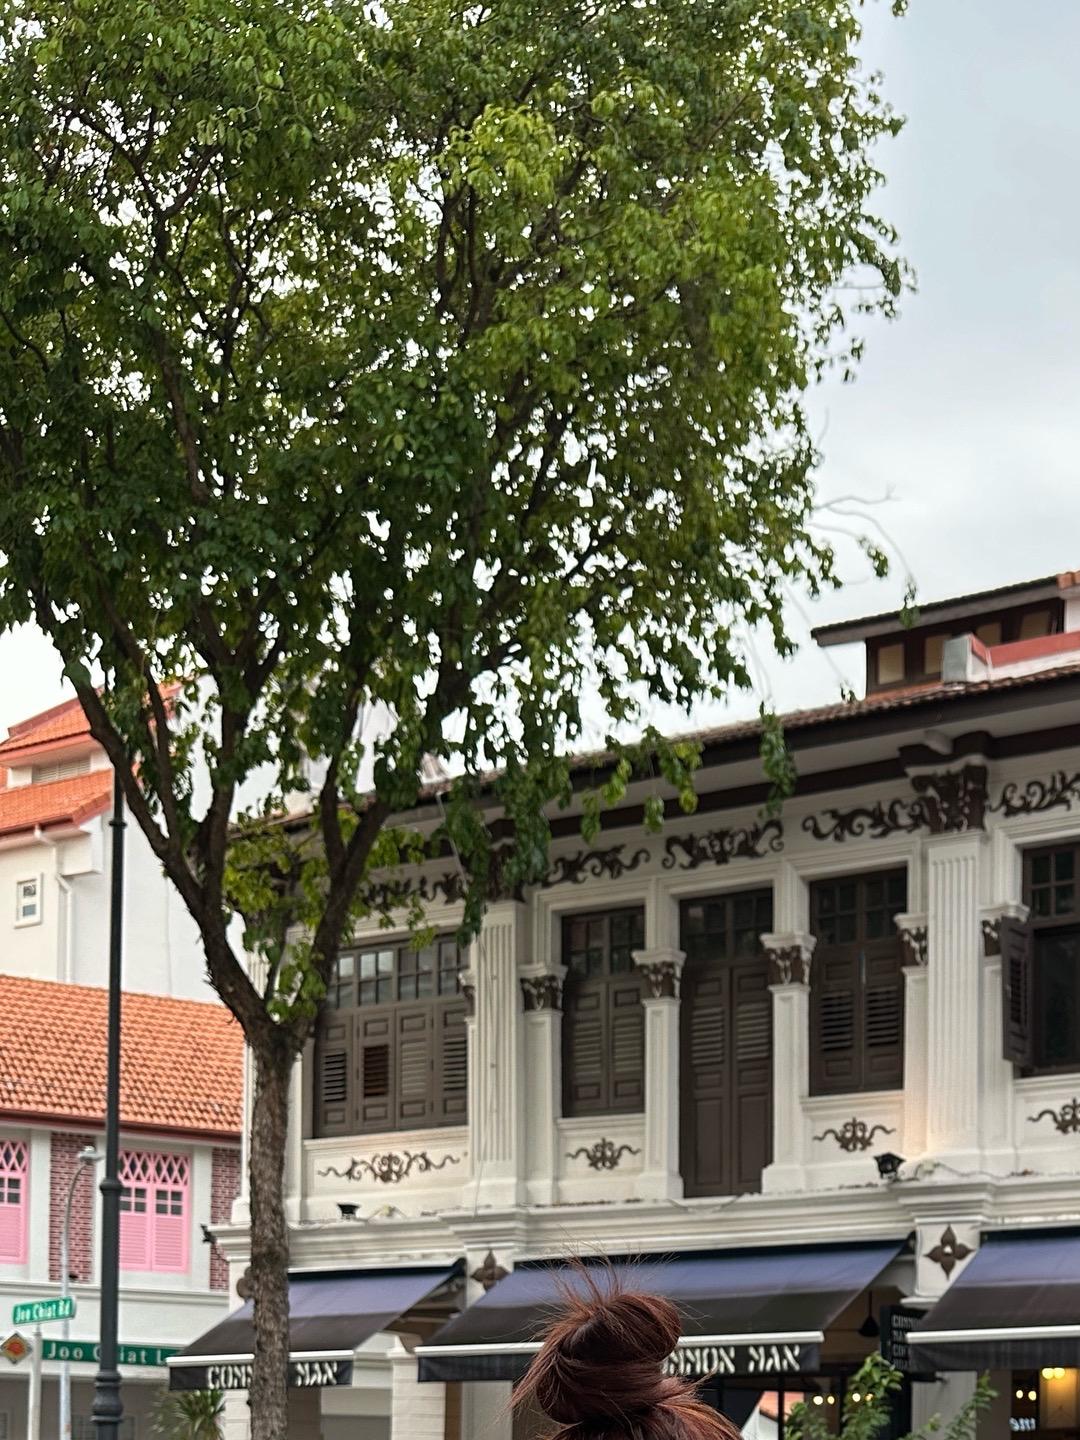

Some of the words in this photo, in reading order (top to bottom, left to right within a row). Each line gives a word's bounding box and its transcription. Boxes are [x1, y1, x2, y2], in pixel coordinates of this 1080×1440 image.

[15, 1306, 31, 1323] Joo
[33, 1303, 56, 1319] Chiat
[59, 1299, 71, 1316] Rd
[49, 1343, 83, 1360] Joo
[93, 1345, 146, 1363] Ciat
[749, 1345, 800, 1374] MAN
[297, 1361, 337, 1387] MAN
